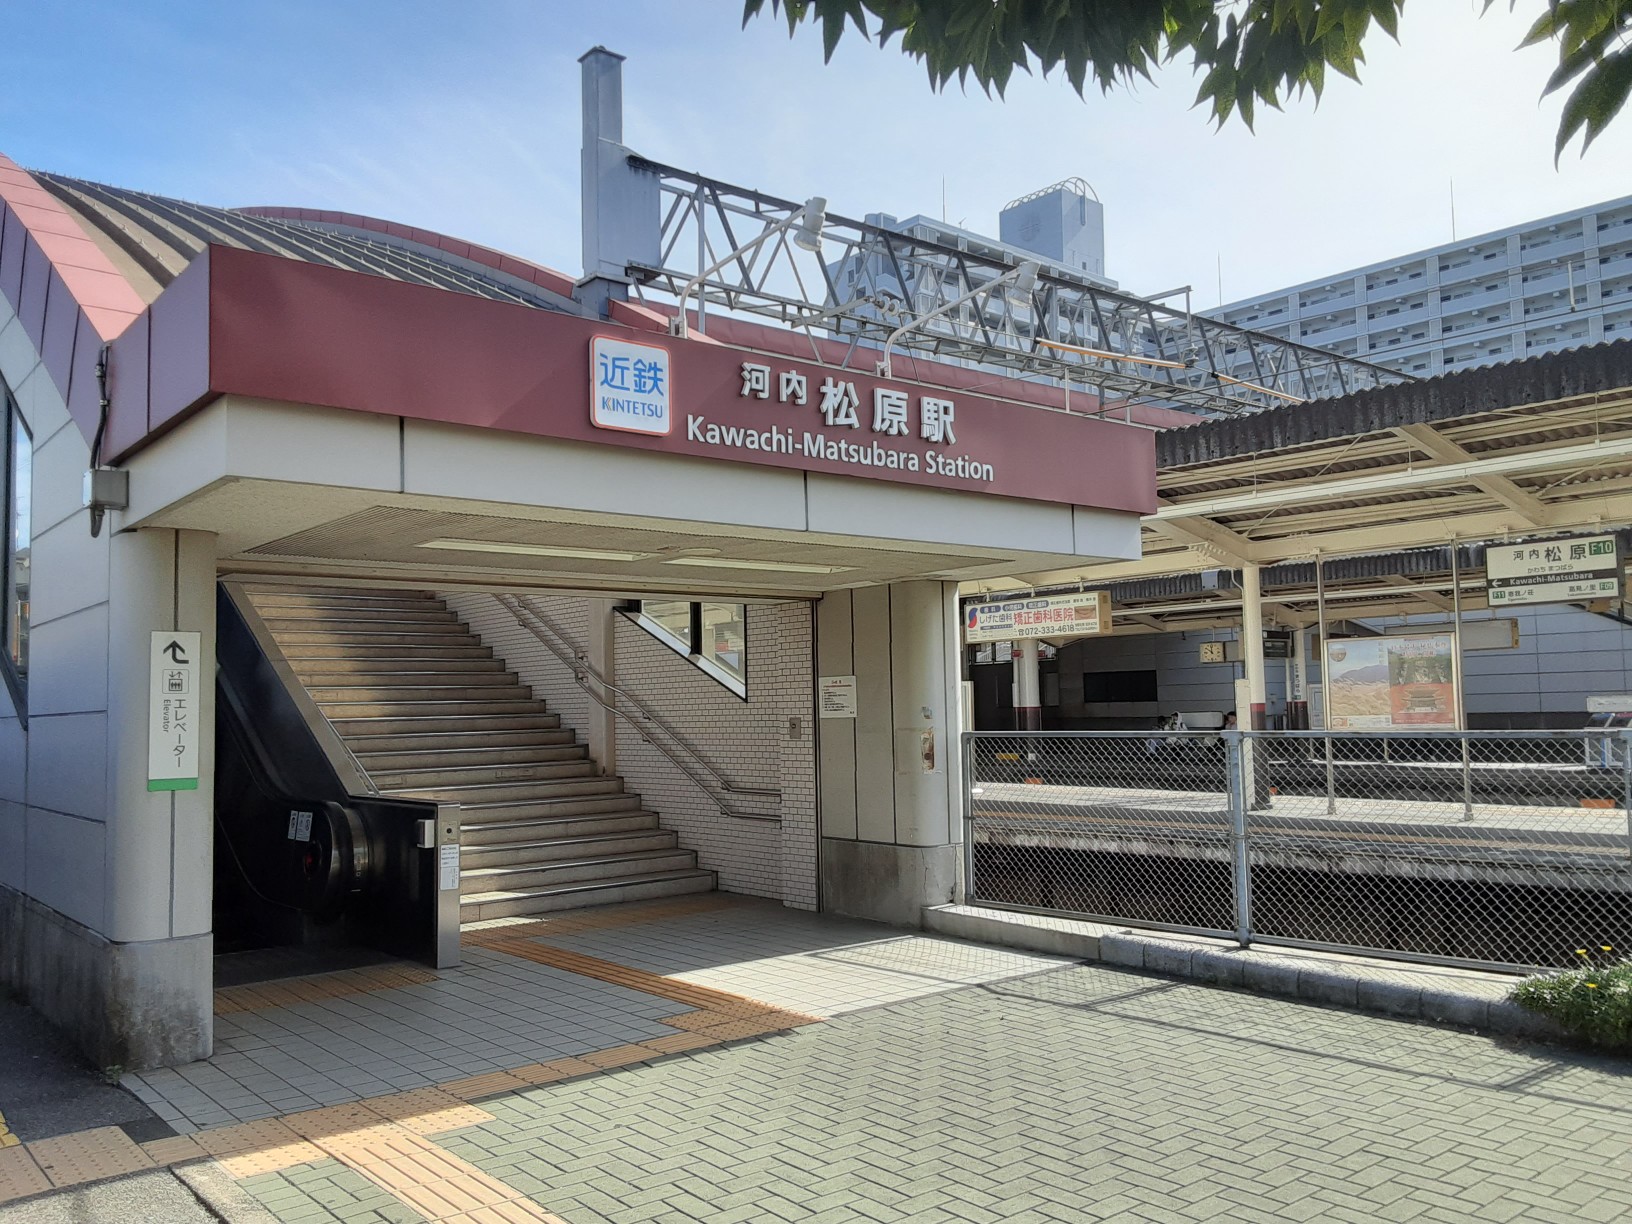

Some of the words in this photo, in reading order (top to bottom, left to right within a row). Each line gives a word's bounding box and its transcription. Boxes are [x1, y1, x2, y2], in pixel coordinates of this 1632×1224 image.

[600, 353, 664, 397] 近鉄
[602, 396, 663, 418] KINTETSU
[740, 361, 957, 445] 河内松原駅
[687, 413, 919, 472] Kawachi-Matsubara
[925, 450, 994, 482] Station
[1513, 544, 1587, 562] 河内松原
[1590, 541, 1612, 554] F10
[1509, 573, 1594, 586] Kawachi-Matsubara
[1013, 607, 1074, 626] 矯正歯科医院
[1025, 623, 1075, 636] 072-333-4618
[163, 699, 171, 733] Elevator
[173, 699, 187, 767] エレベーター
